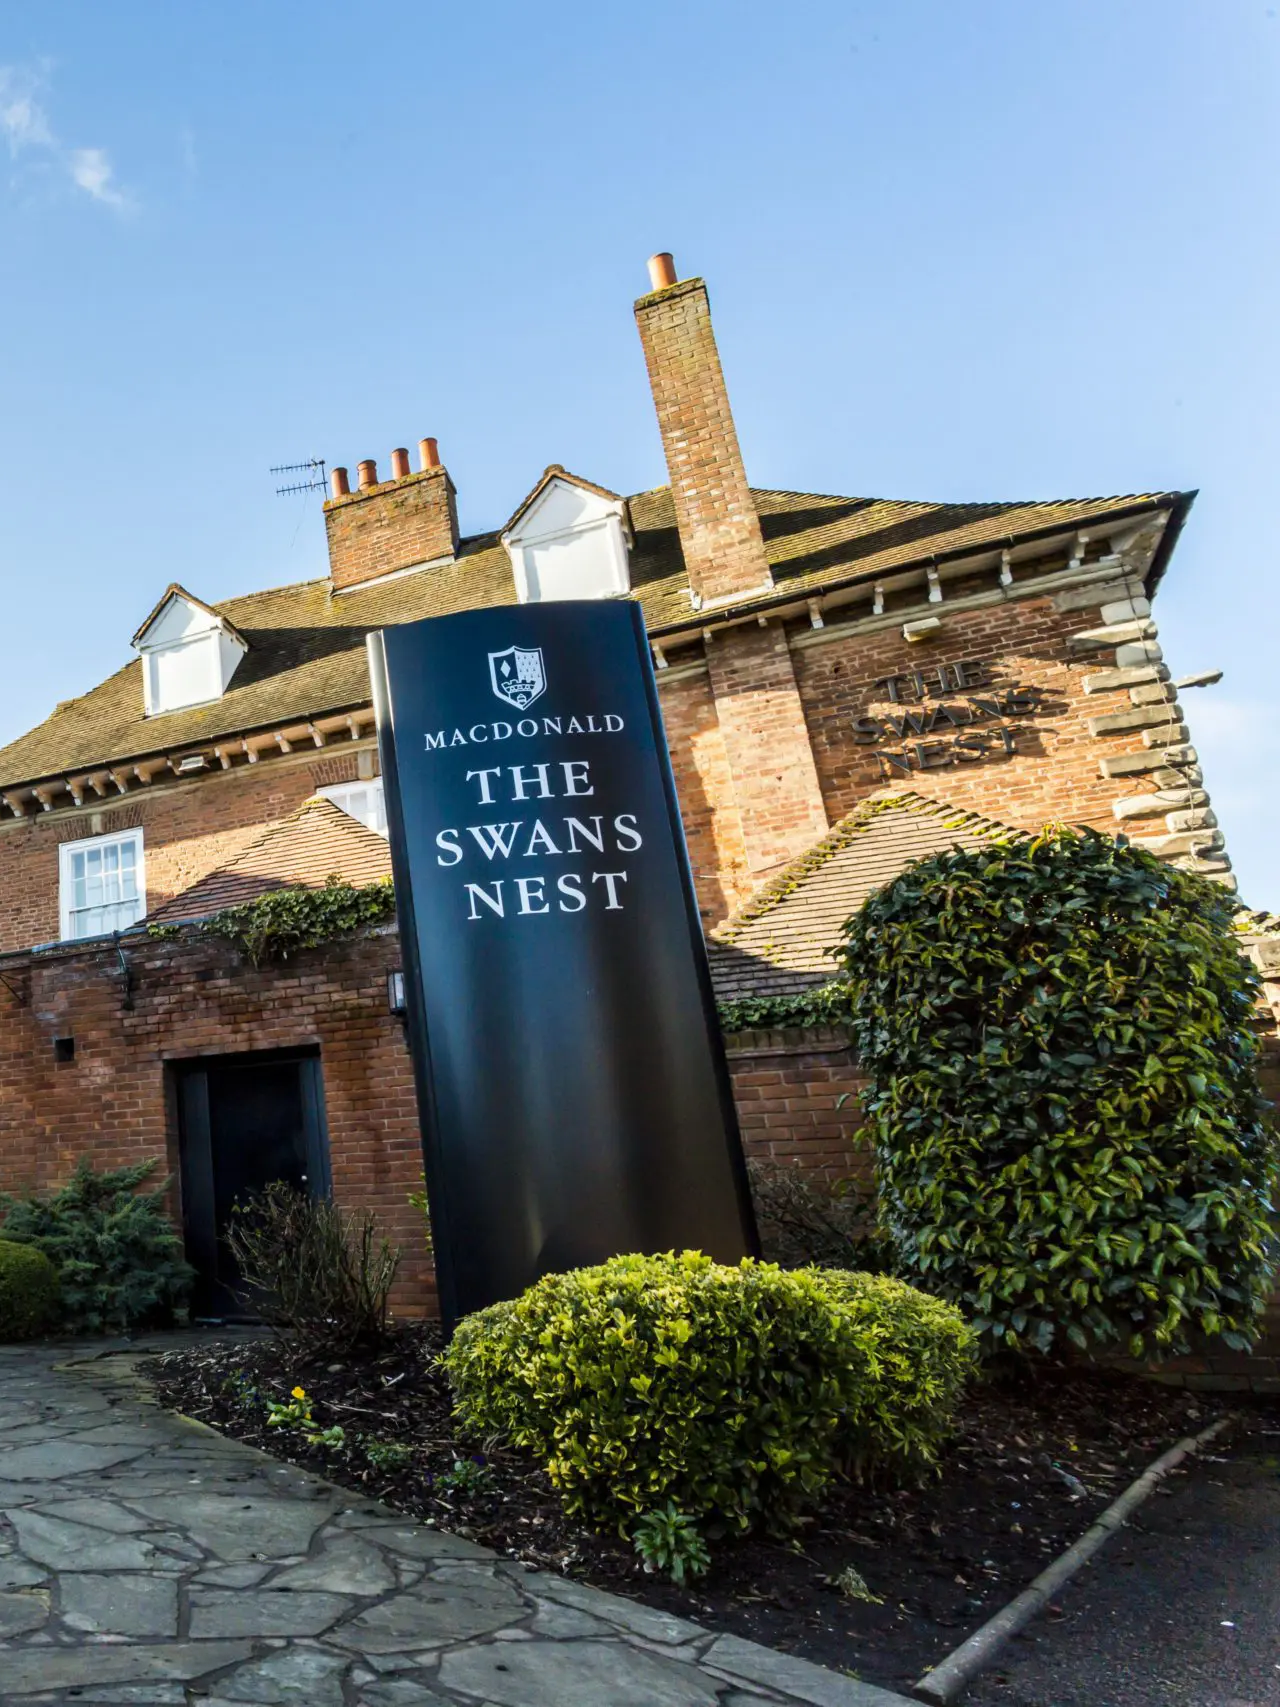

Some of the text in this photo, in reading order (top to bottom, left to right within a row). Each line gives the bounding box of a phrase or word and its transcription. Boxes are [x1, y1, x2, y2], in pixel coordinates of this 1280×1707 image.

[875, 660, 985, 703] THE
[424, 714, 625, 751] MACDONALD
[852, 686, 1039, 745] SWANS
[874, 723, 1022, 777] NEST
[466, 761, 595, 805] THE
[435, 814, 643, 867] SWANS
[464, 871, 627, 920] NEST
